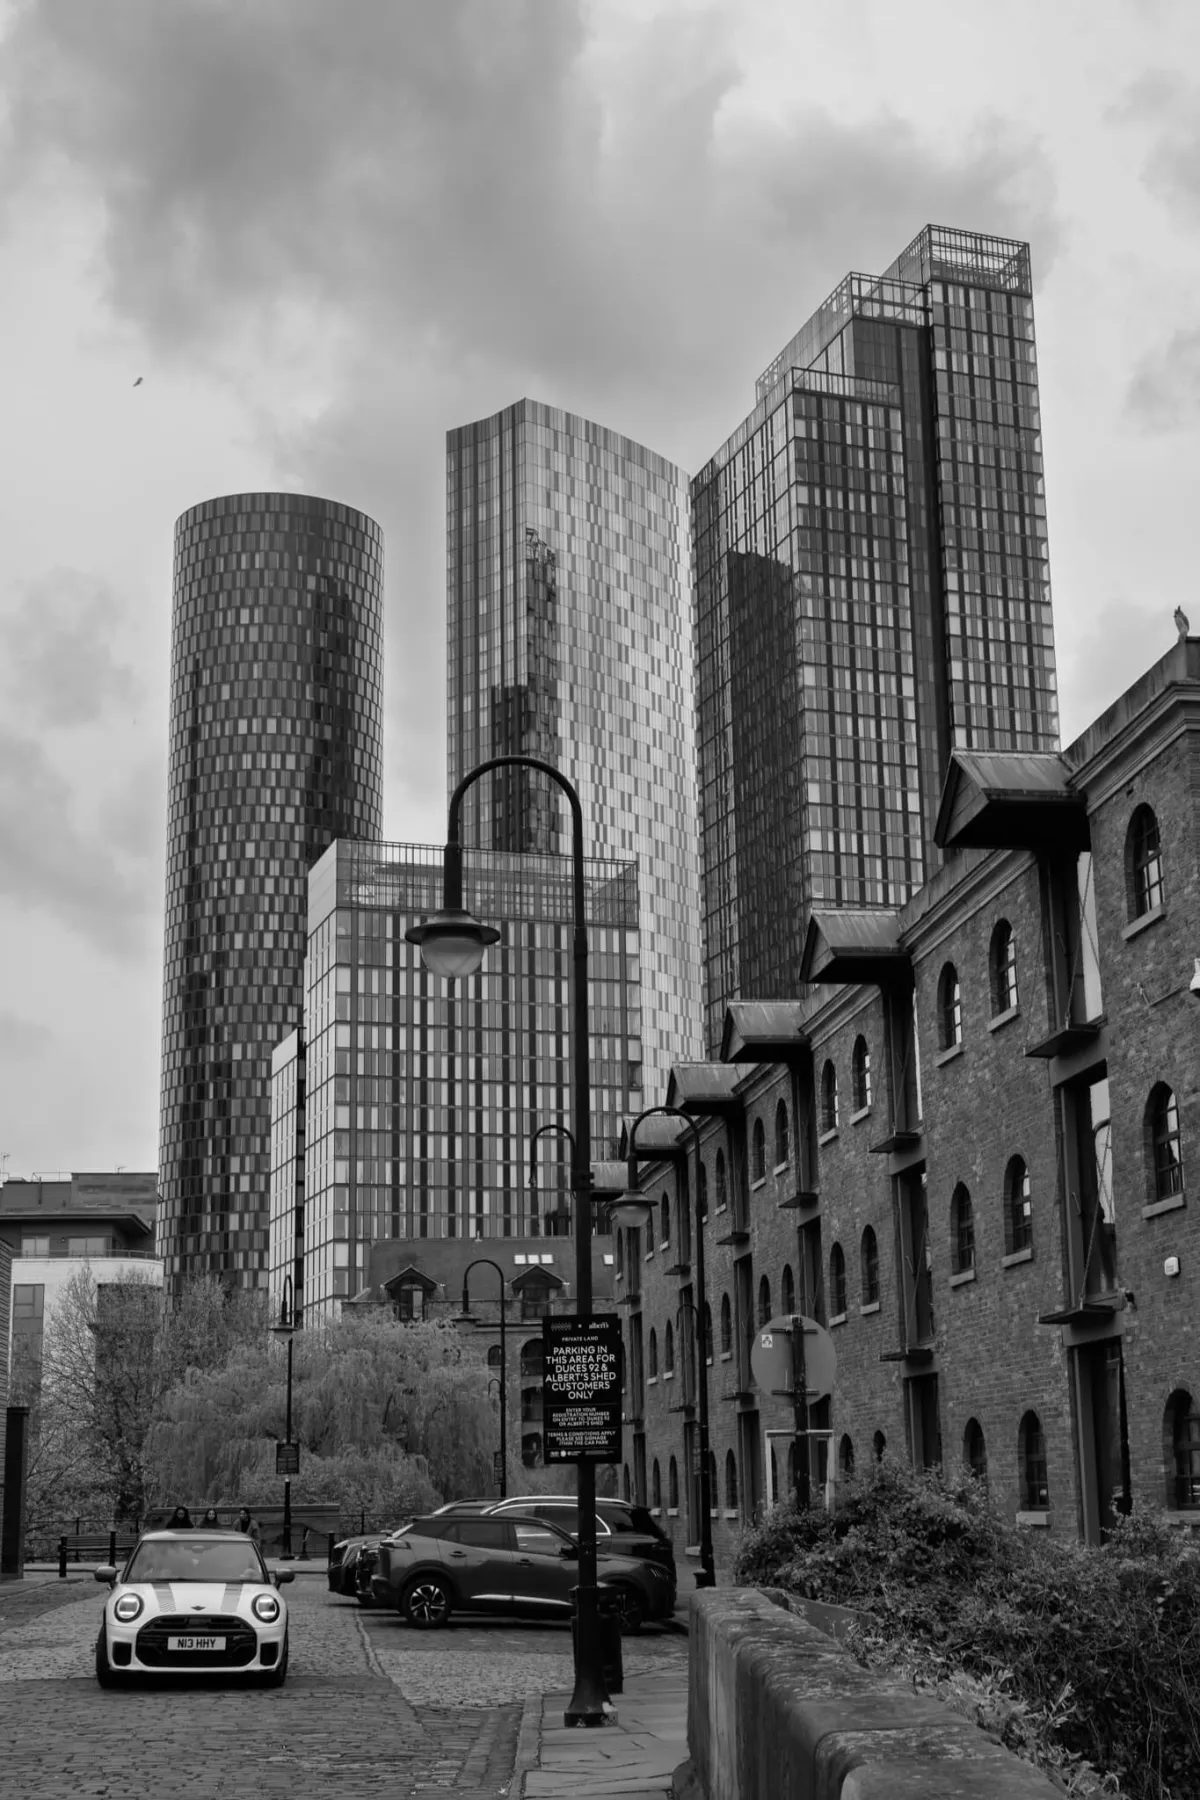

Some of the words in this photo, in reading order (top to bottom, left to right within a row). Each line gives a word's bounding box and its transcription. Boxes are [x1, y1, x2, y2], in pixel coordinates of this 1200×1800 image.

[553, 1345, 595, 1355] PARKING
[597, 1344, 607, 1354] IN
[546, 1355, 567, 1364] THIS
[569, 1355, 595, 1364] AREA
[596, 1354, 616, 1362] FOR
[555, 1364, 587, 1373] DUKES
[588, 1364, 599, 1372] 92
[601, 1363, 608, 1372] &
[545, 1372, 589, 1382] ALBERT'S
[591, 1372, 616, 1381] SHED
[552, 1381, 610, 1391] CUSTOMERS
[568, 1390, 594, 1399] ONLY
[177, 1638, 193, 1648] N13
[196, 1638, 216, 1648] HHY
